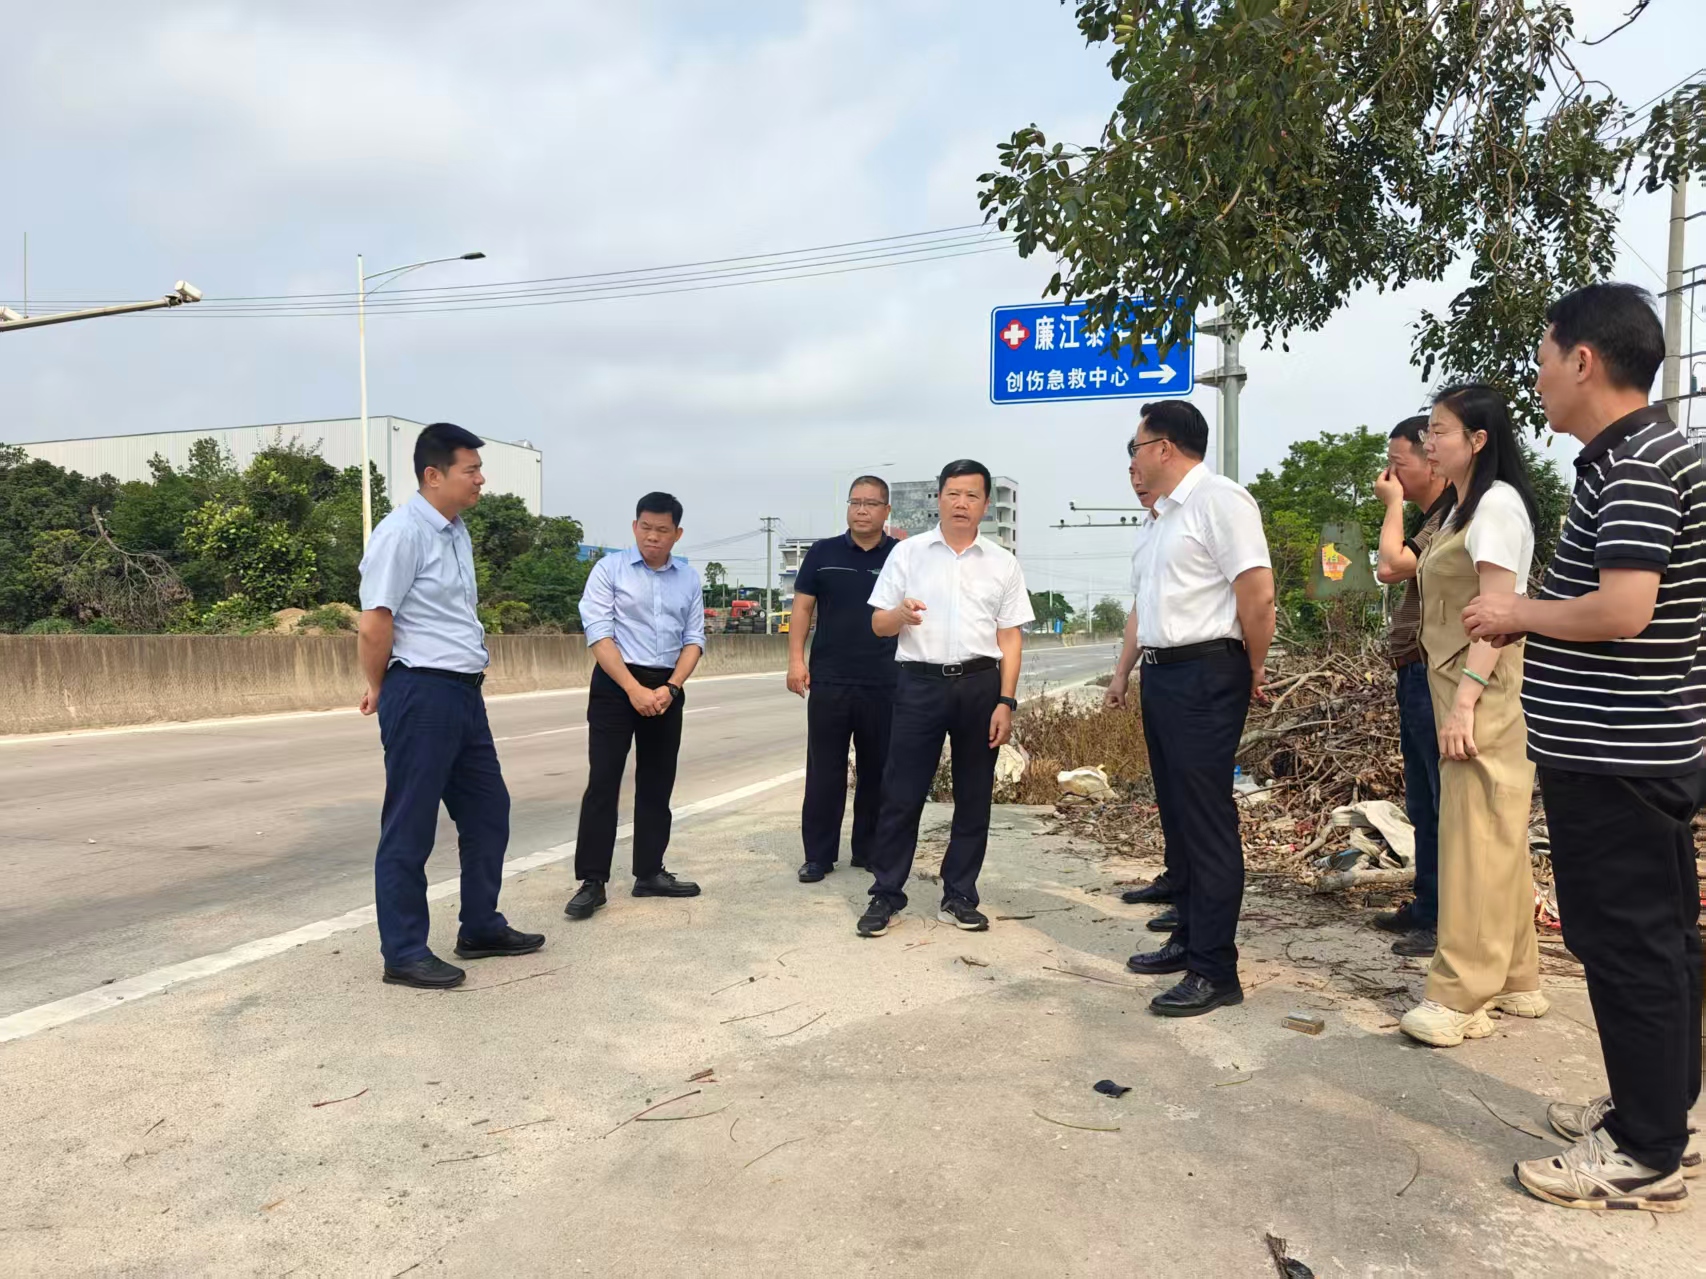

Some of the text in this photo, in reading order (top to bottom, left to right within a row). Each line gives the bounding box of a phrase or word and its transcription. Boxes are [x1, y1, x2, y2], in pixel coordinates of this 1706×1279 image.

[1005, 365, 1130, 392] 创伤急救中心
